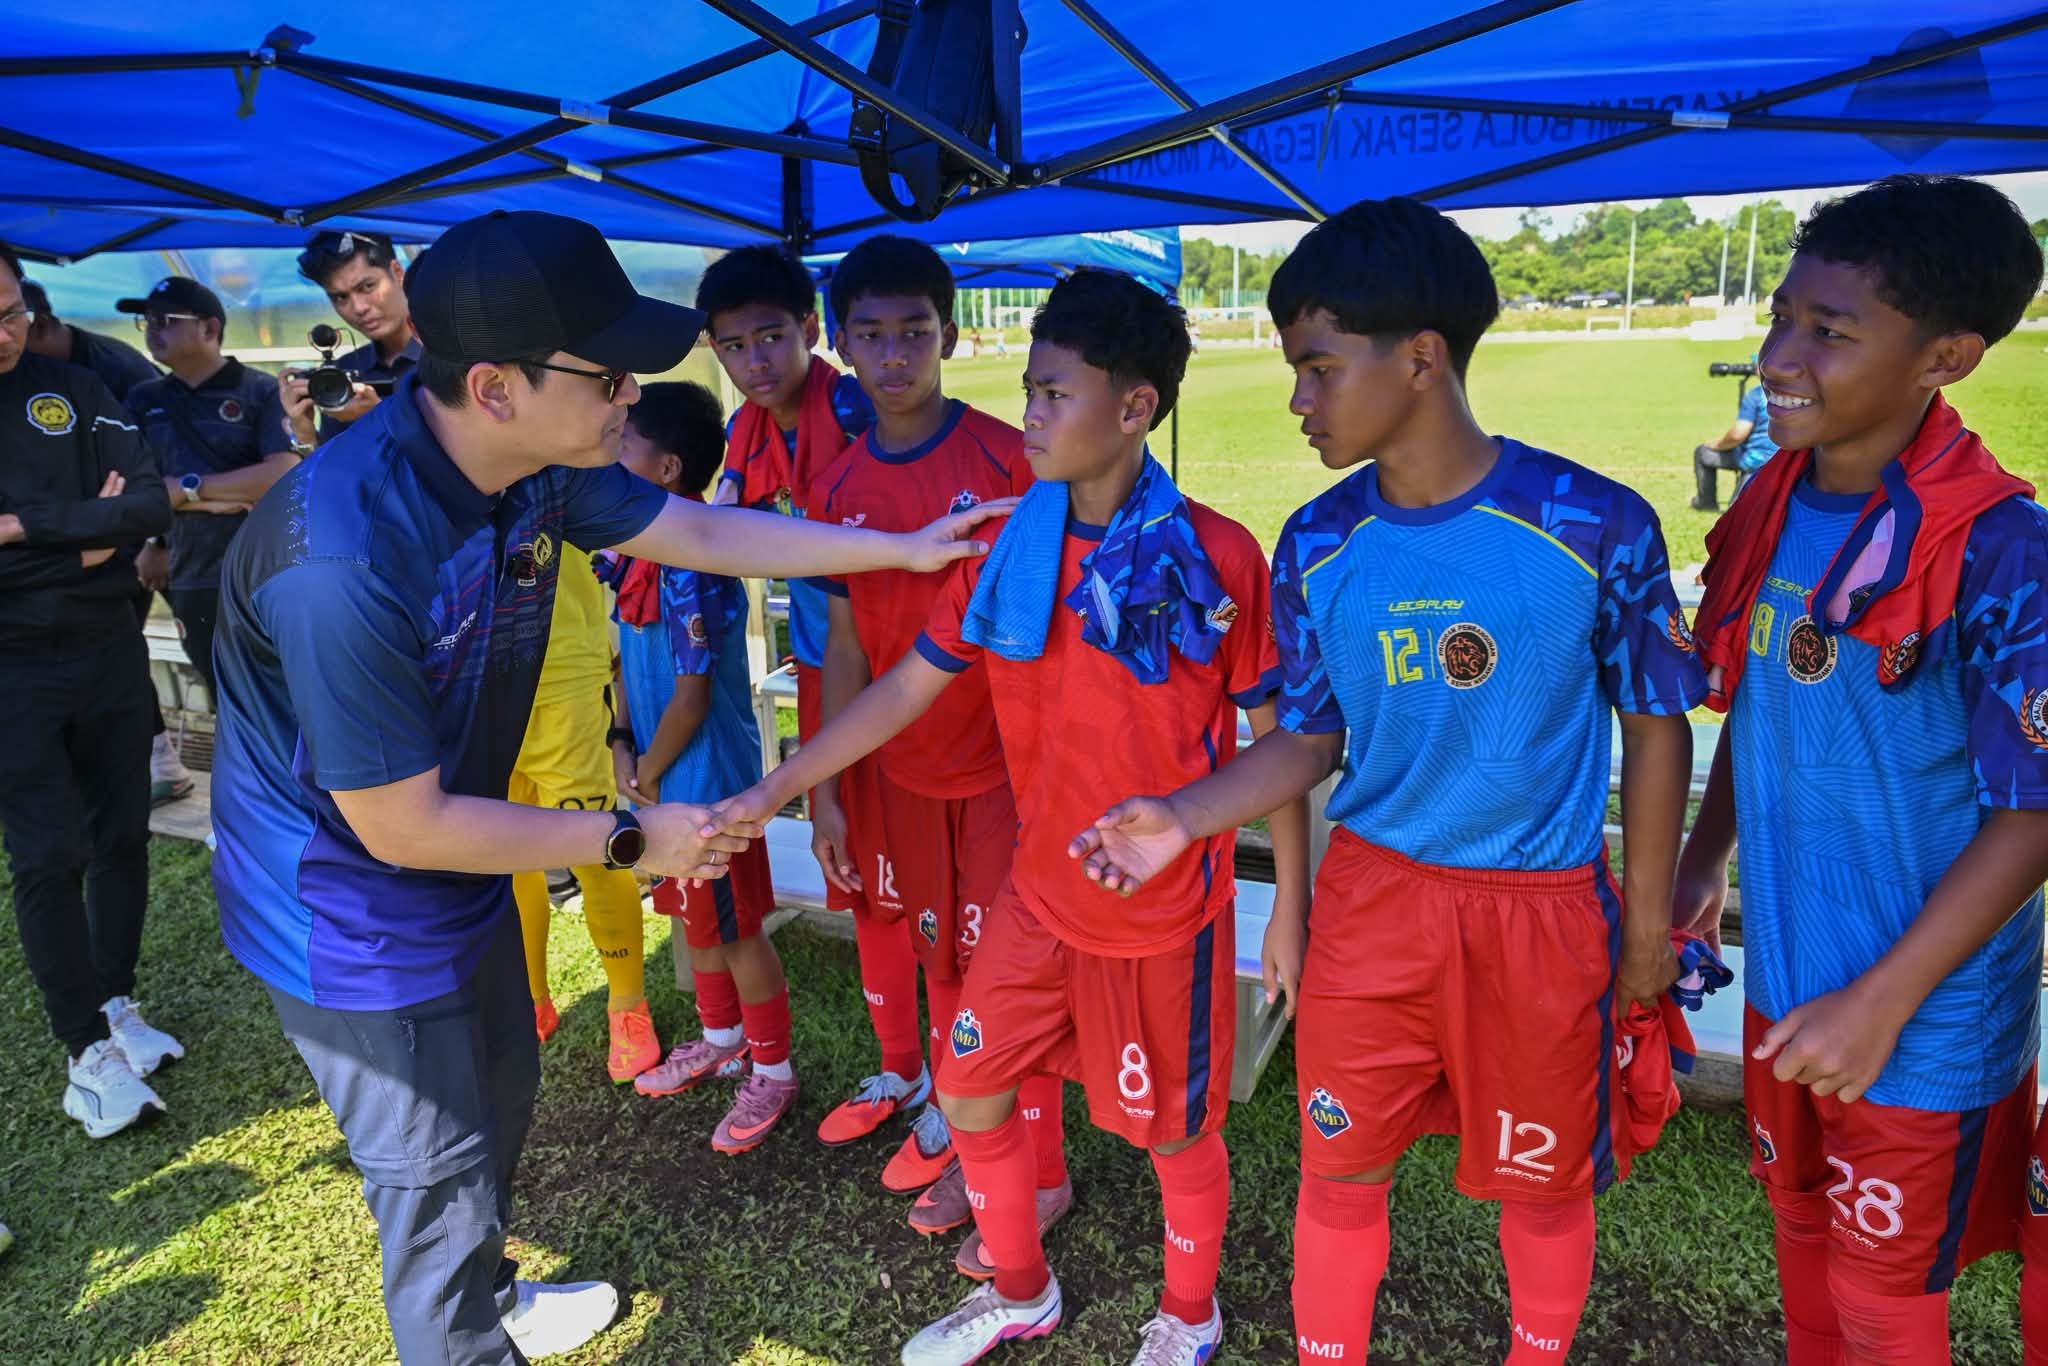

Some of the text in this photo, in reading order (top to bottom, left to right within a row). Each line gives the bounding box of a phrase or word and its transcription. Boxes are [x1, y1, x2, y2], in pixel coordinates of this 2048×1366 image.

[1377, 627, 1424, 686] 12
[1118, 1042, 1151, 1100] 8
[1311, 1108, 1345, 1126] AMD
[1497, 1109, 1557, 1172] 12
[1826, 1155, 1904, 1240] 28
[1300, 1335, 1345, 1359] AMD
[1515, 1324, 1560, 1351] AMD
